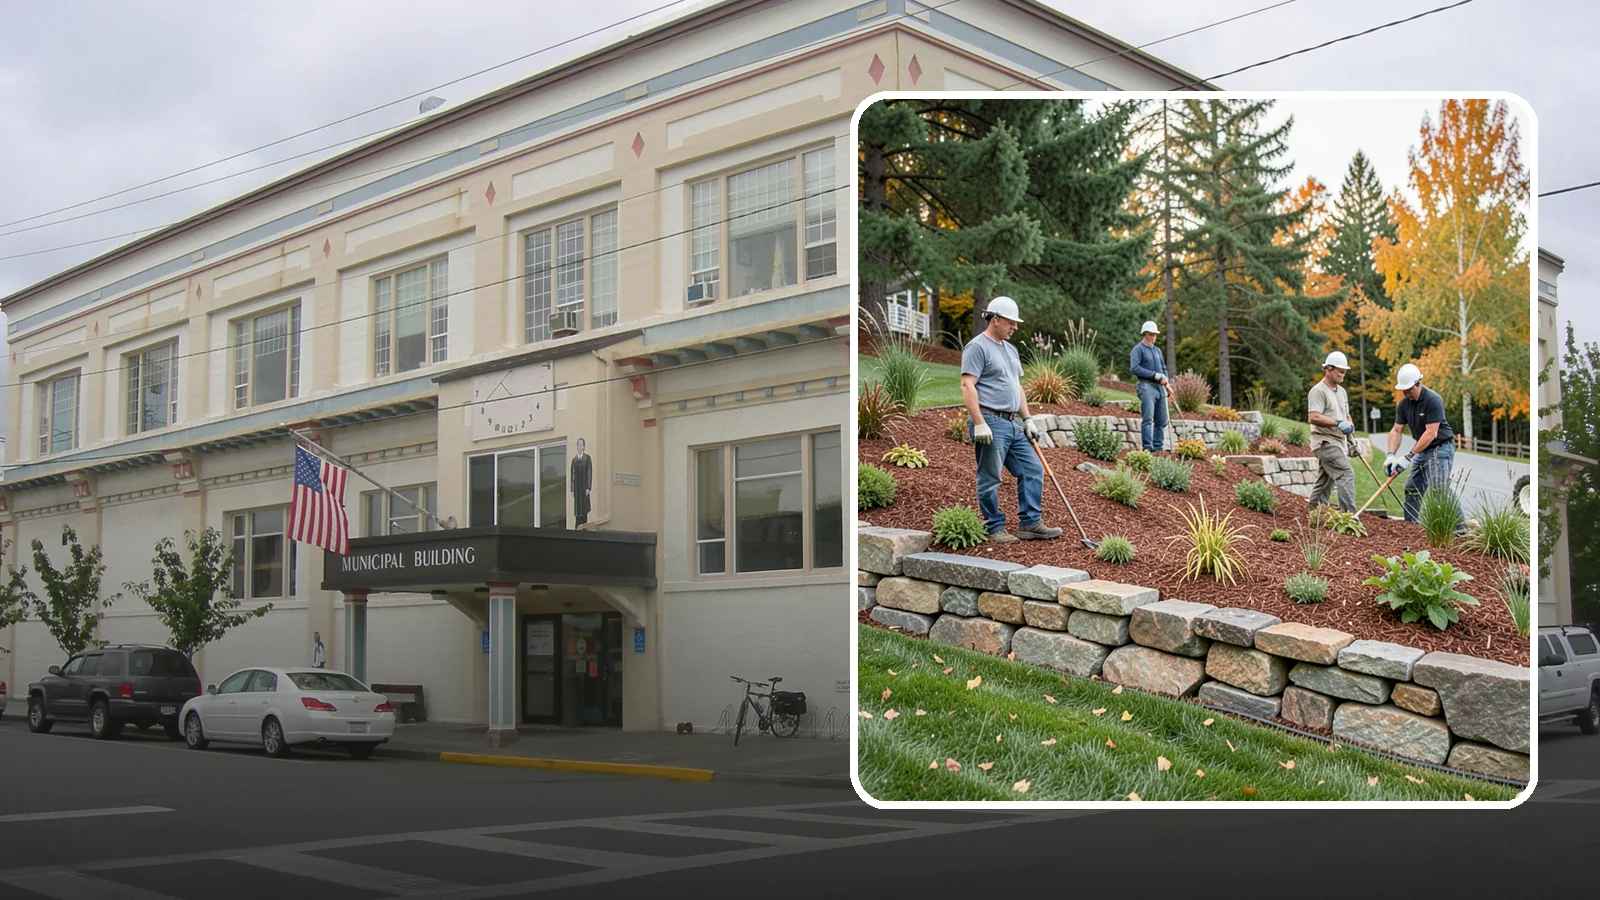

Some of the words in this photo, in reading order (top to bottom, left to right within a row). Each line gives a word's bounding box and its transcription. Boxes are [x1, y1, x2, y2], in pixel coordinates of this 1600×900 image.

[475, 390, 479, 398] 7
[480, 406, 485, 415] 8
[536, 402, 540, 410] 4
[487, 417, 492, 426] 9
[528, 413, 533, 422] 3
[494, 423, 500, 432] 10
[520, 420, 526, 428] 2
[501, 426, 506, 434] 11
[507, 424, 514, 434] 12
[342, 552, 405, 572] MUNICIPAL
[414, 546, 475, 567] BUILDING
